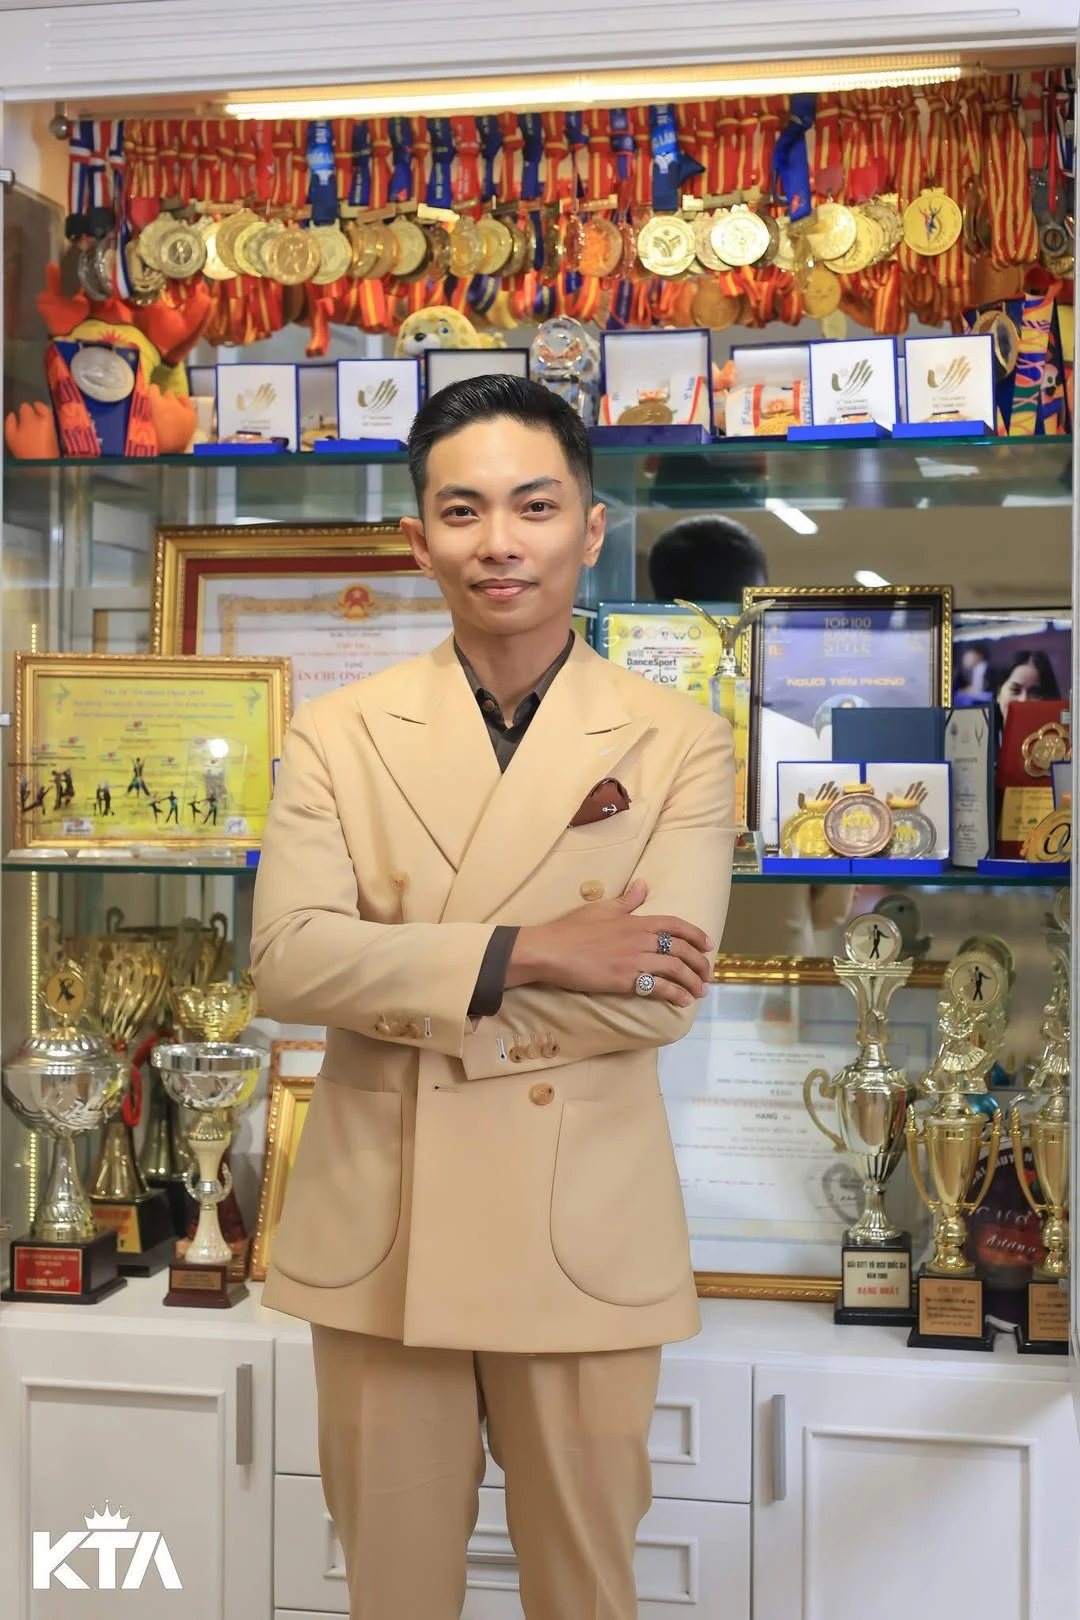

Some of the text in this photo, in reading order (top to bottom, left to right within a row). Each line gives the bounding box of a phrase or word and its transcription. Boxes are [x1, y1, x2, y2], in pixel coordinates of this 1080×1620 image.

[823, 617, 872, 628] TOP 100
[627, 657, 677, 667] DanceSport
